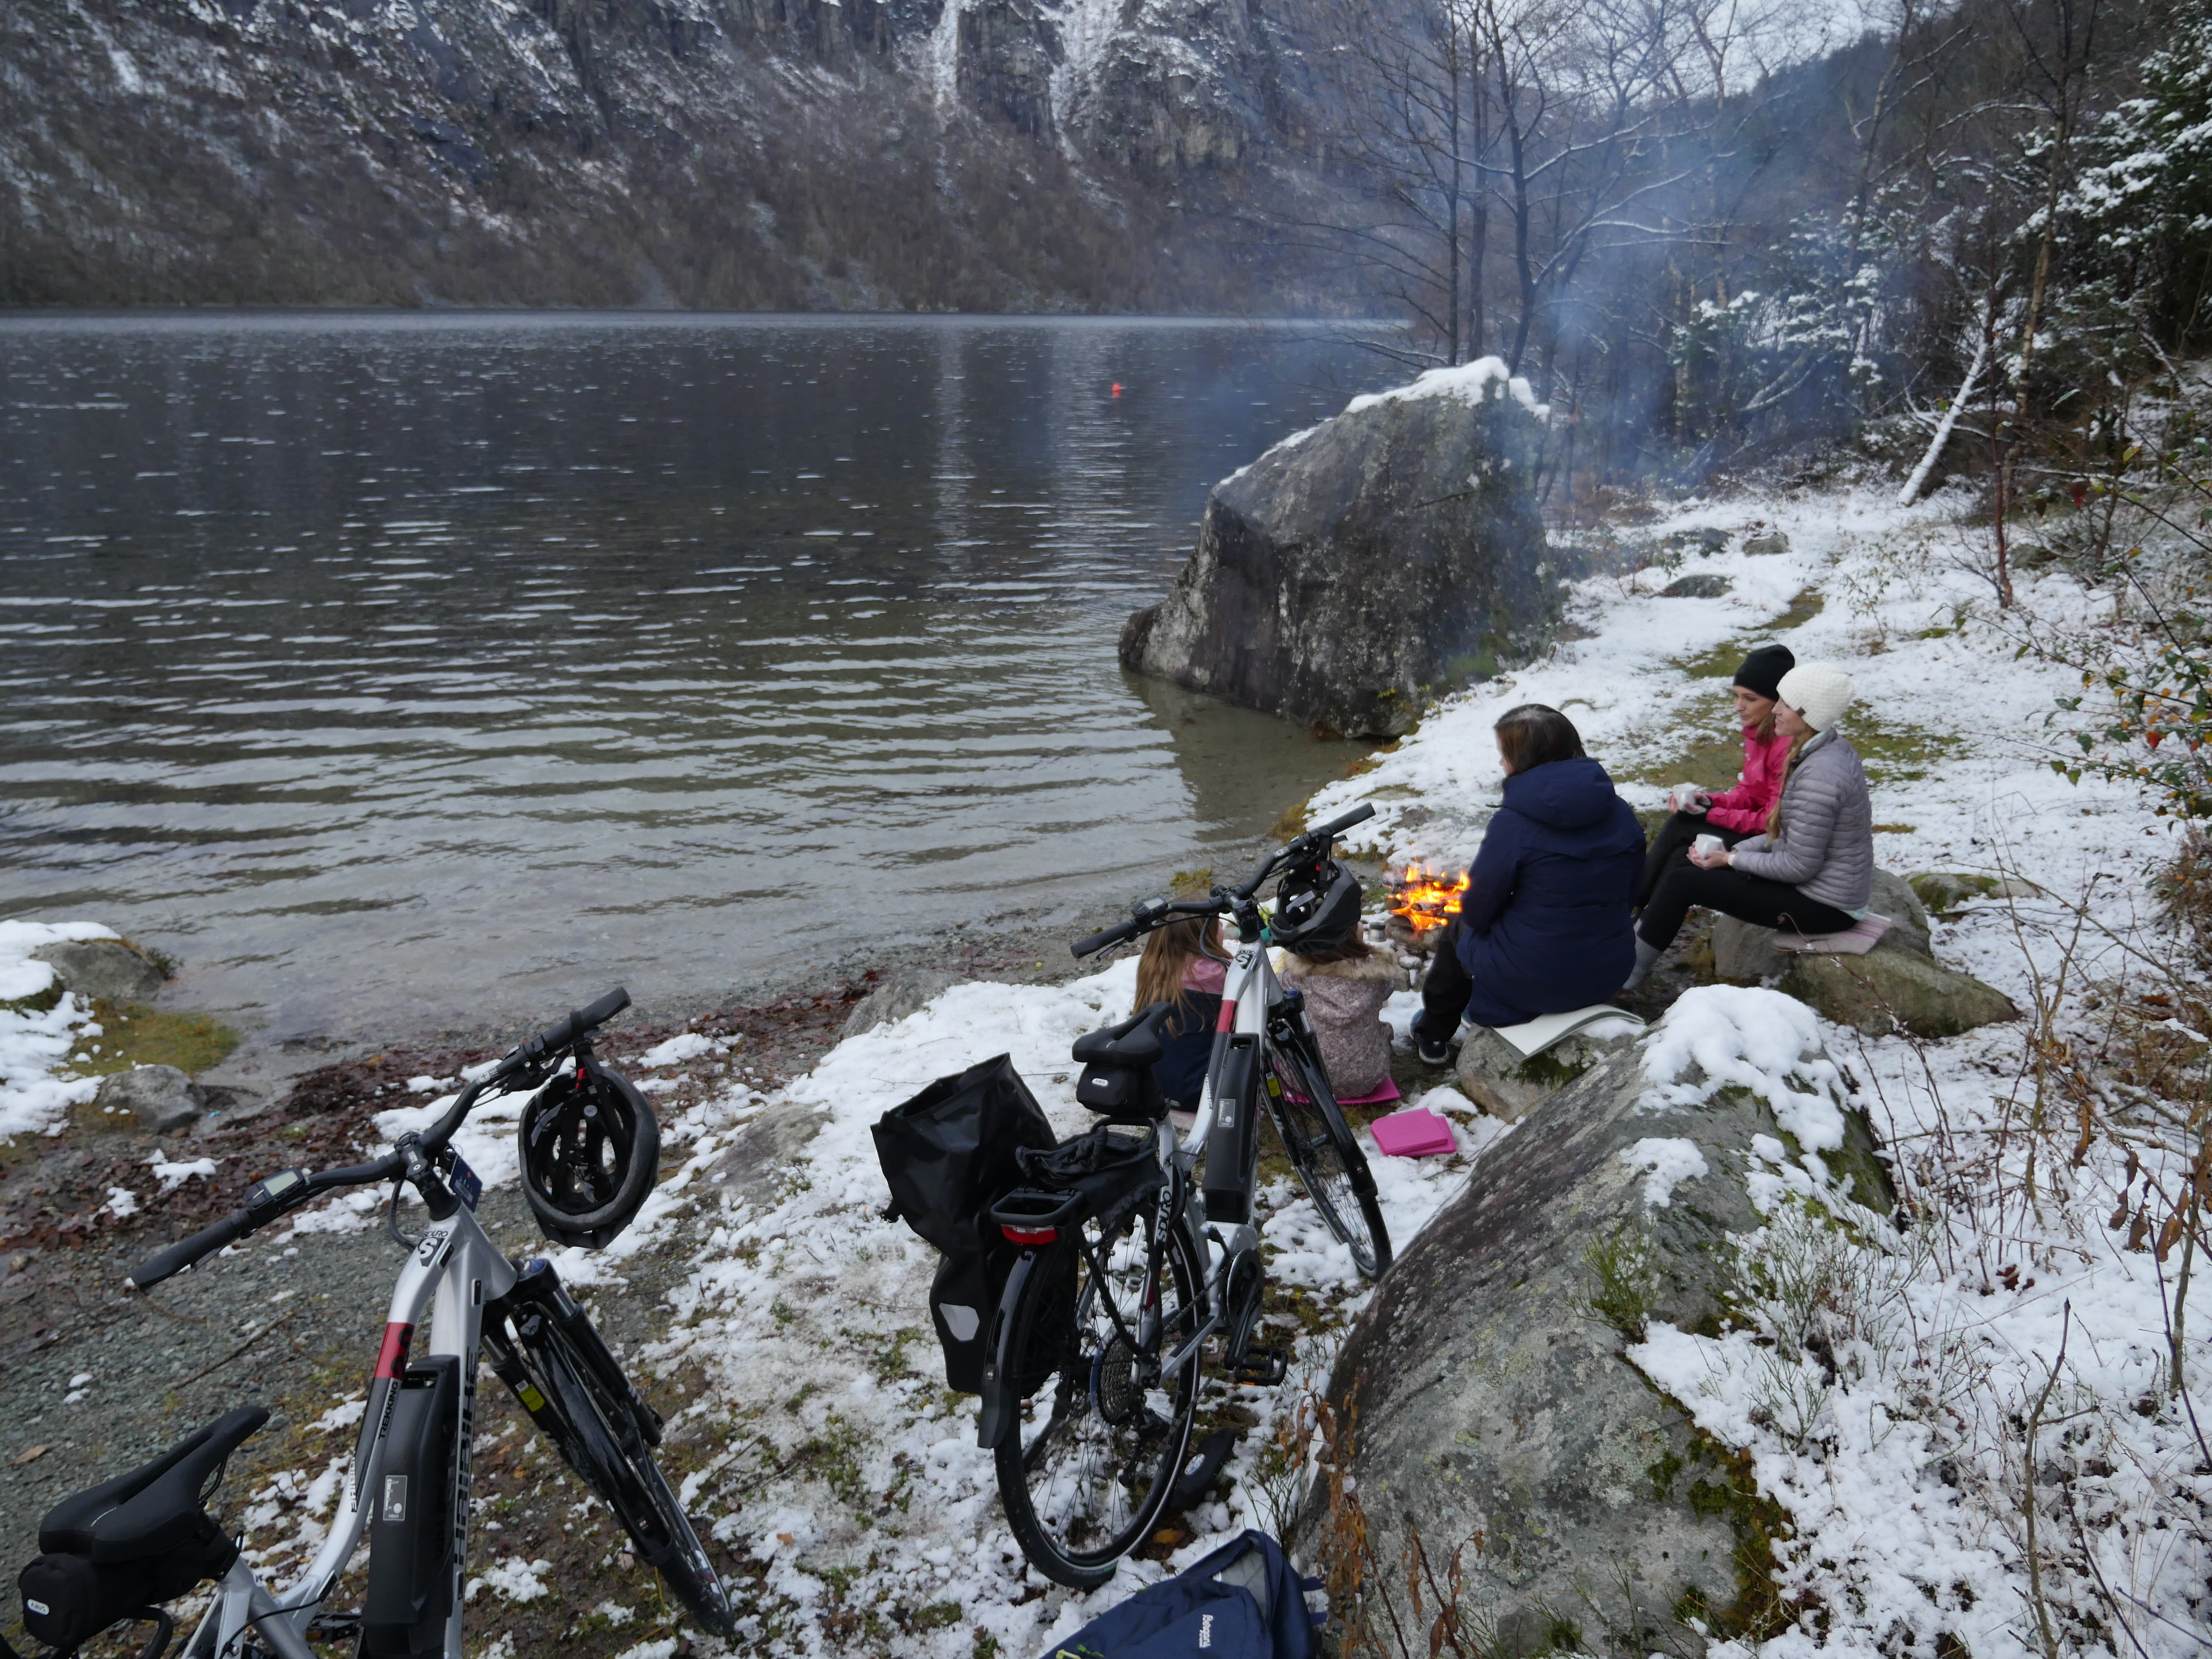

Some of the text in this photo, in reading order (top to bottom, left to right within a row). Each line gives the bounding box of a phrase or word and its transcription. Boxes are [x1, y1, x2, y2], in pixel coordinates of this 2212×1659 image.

[1155, 1190, 1172, 1243] SDURO
[378, 1380, 399, 1440] TREKKING
[454, 1346, 478, 1566] HAIBIKE
